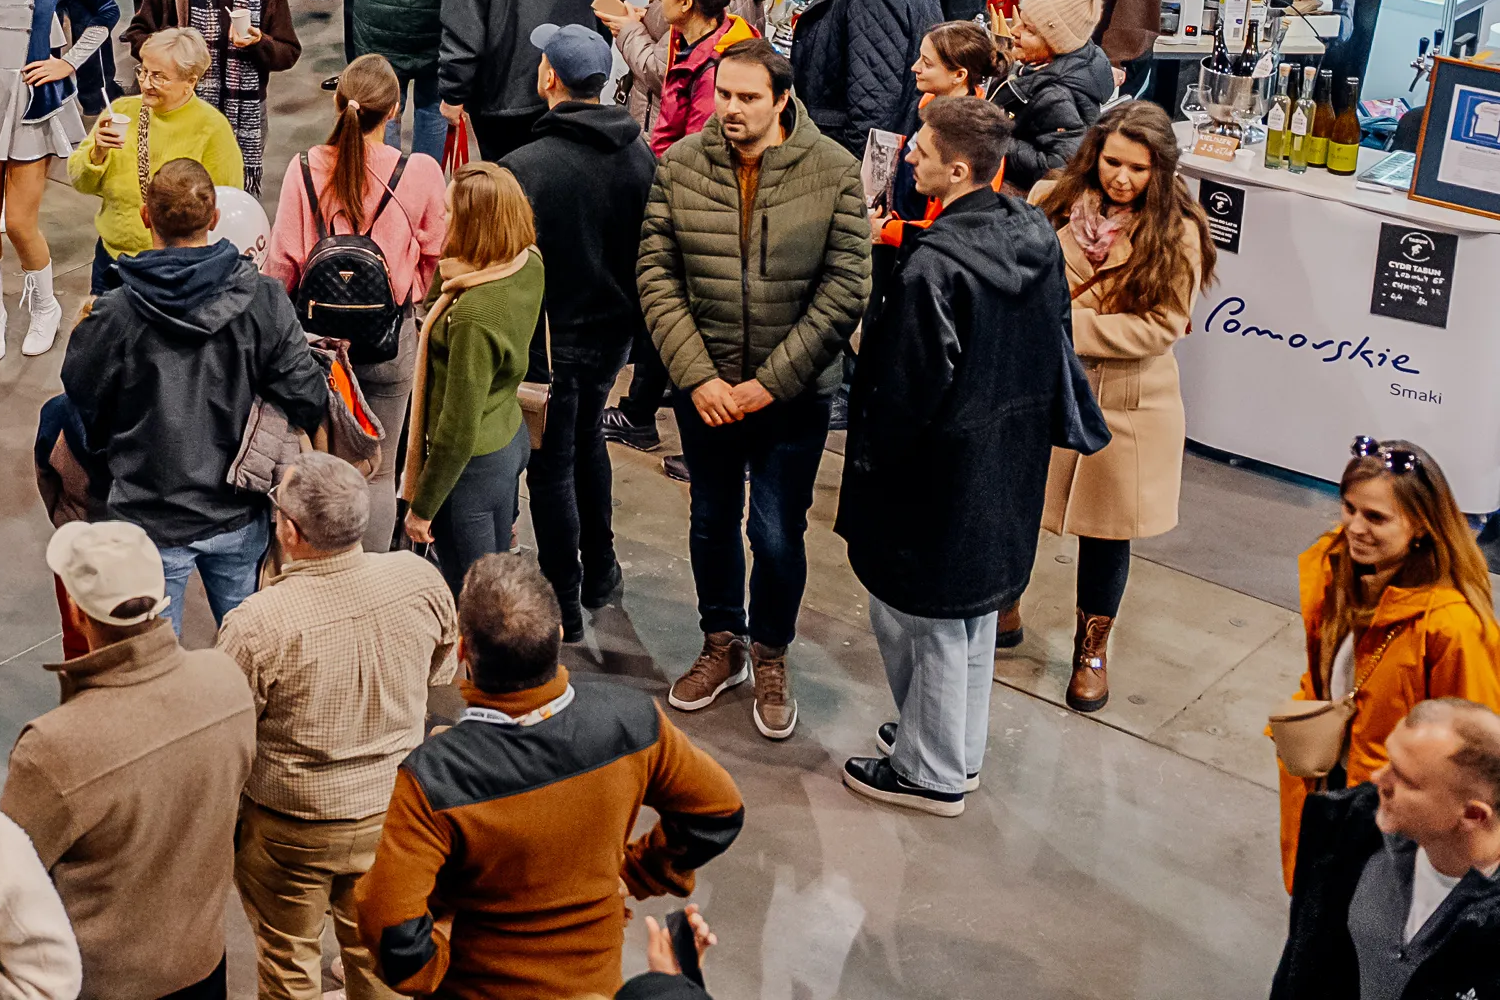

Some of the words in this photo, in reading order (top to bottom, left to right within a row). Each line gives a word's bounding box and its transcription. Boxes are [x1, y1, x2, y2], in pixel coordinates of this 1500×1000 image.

[1408, 237, 1428, 245] TABUN
[1388, 260, 1412, 271] CYDR
[1413, 265, 1442, 277] TABUN
[1204, 297, 1420, 374] Pomorskie
[1389, 383, 1443, 404] Smaki
